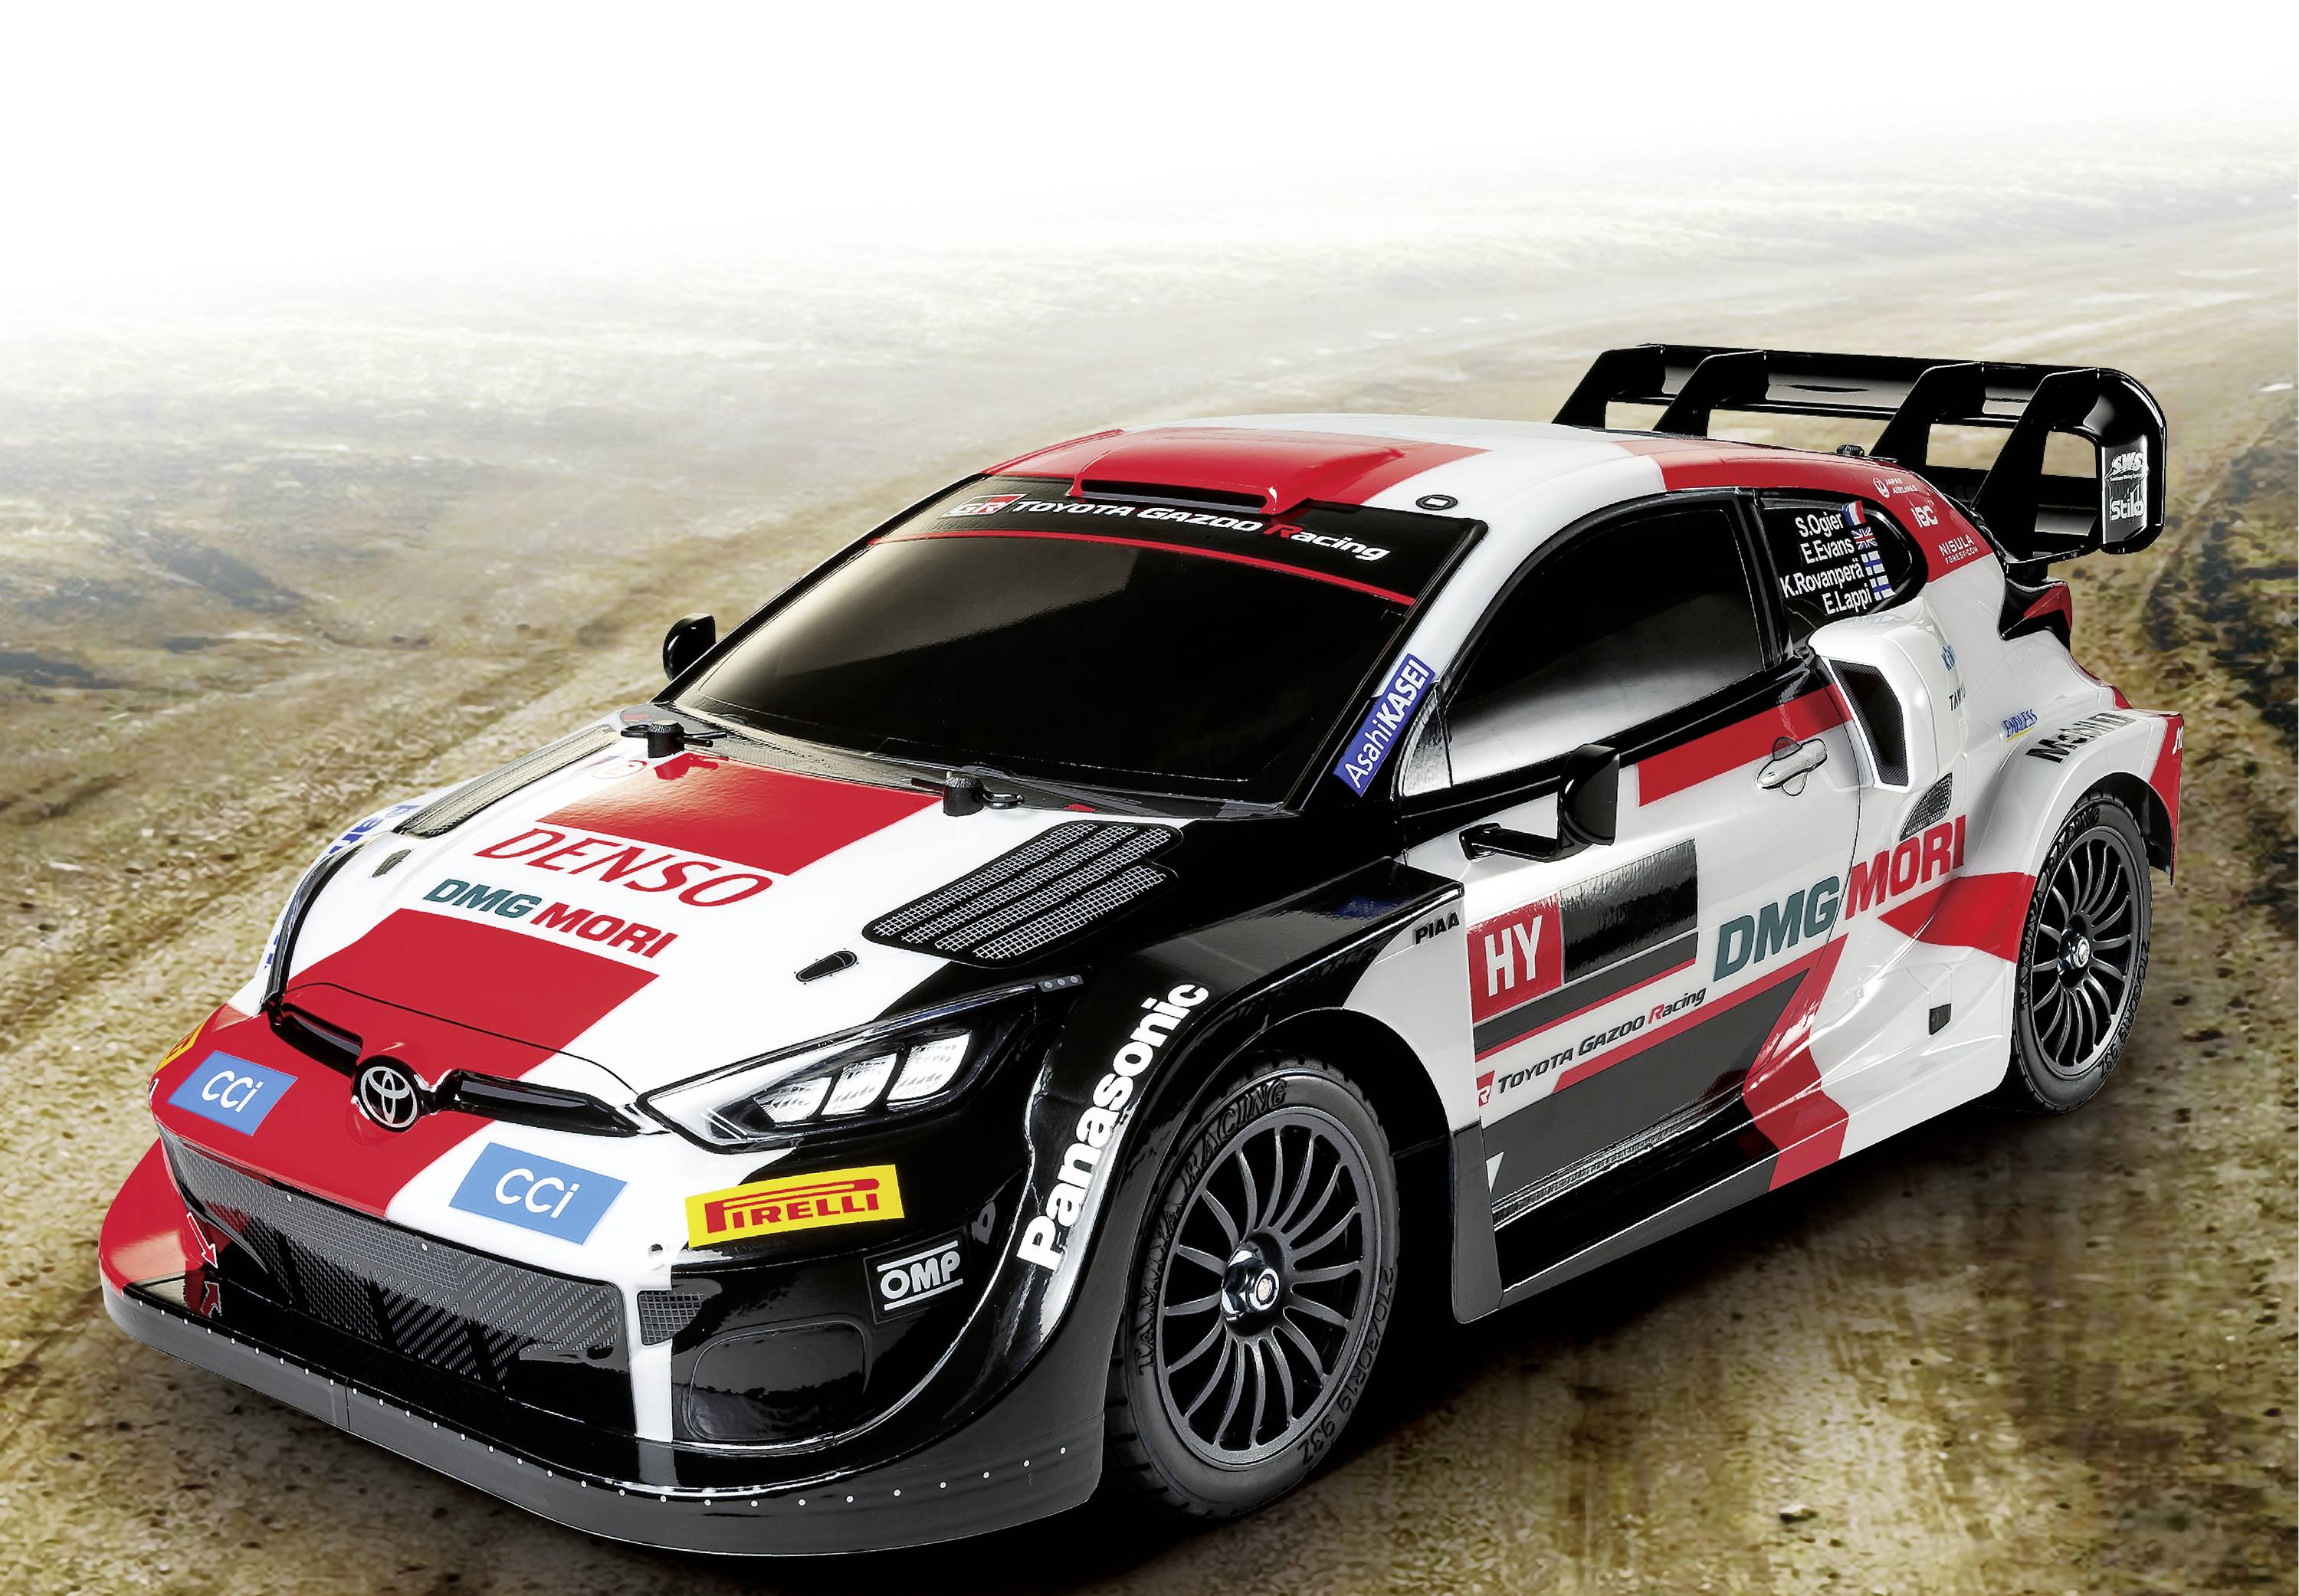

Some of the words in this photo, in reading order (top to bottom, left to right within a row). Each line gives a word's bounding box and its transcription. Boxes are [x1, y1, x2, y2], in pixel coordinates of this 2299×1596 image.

[1885, 477, 1903, 487] JAPAN
[1893, 484, 1918, 494] AIRLINES
[2111, 491, 2143, 521] Stilo
[953, 498, 1002, 516] GR
[1012, 500, 1133, 518] TOYOTA
[1136, 506, 1263, 533] GAZOO
[1263, 523, 1390, 562] Racing
[1796, 511, 1843, 538] S.Ogier
[1939, 534, 1975, 556] NISULA
[1801, 537, 1855, 565] E.Evans
[1779, 558, 1864, 598] K.Rovanperä
[1822, 585, 1872, 615] E.Lappi
[1345, 659, 1429, 788] AsahiKASEI
[2003, 709, 2038, 738] ENDLESS
[473, 828, 772, 907] DENSO
[423, 879, 542, 918] DMG
[530, 902, 678, 958] MORI
[1714, 875, 1841, 982] DMG
[1845, 815, 1966, 920] MORI
[1415, 911, 1460, 944] PIAA
[1484, 916, 1545, 997] HY
[1497, 1050, 1573, 1094] TOYOTA
[1579, 1016, 1645, 1056] GAZOO
[1648, 987, 1707, 1024] Racing
[1017, 982, 1209, 1271] Panasonic
[1183, 1080, 1288, 1195] RACING
[704, 1178, 880, 1234] PIRELLI
[880, 1250, 960, 1299] OMP
